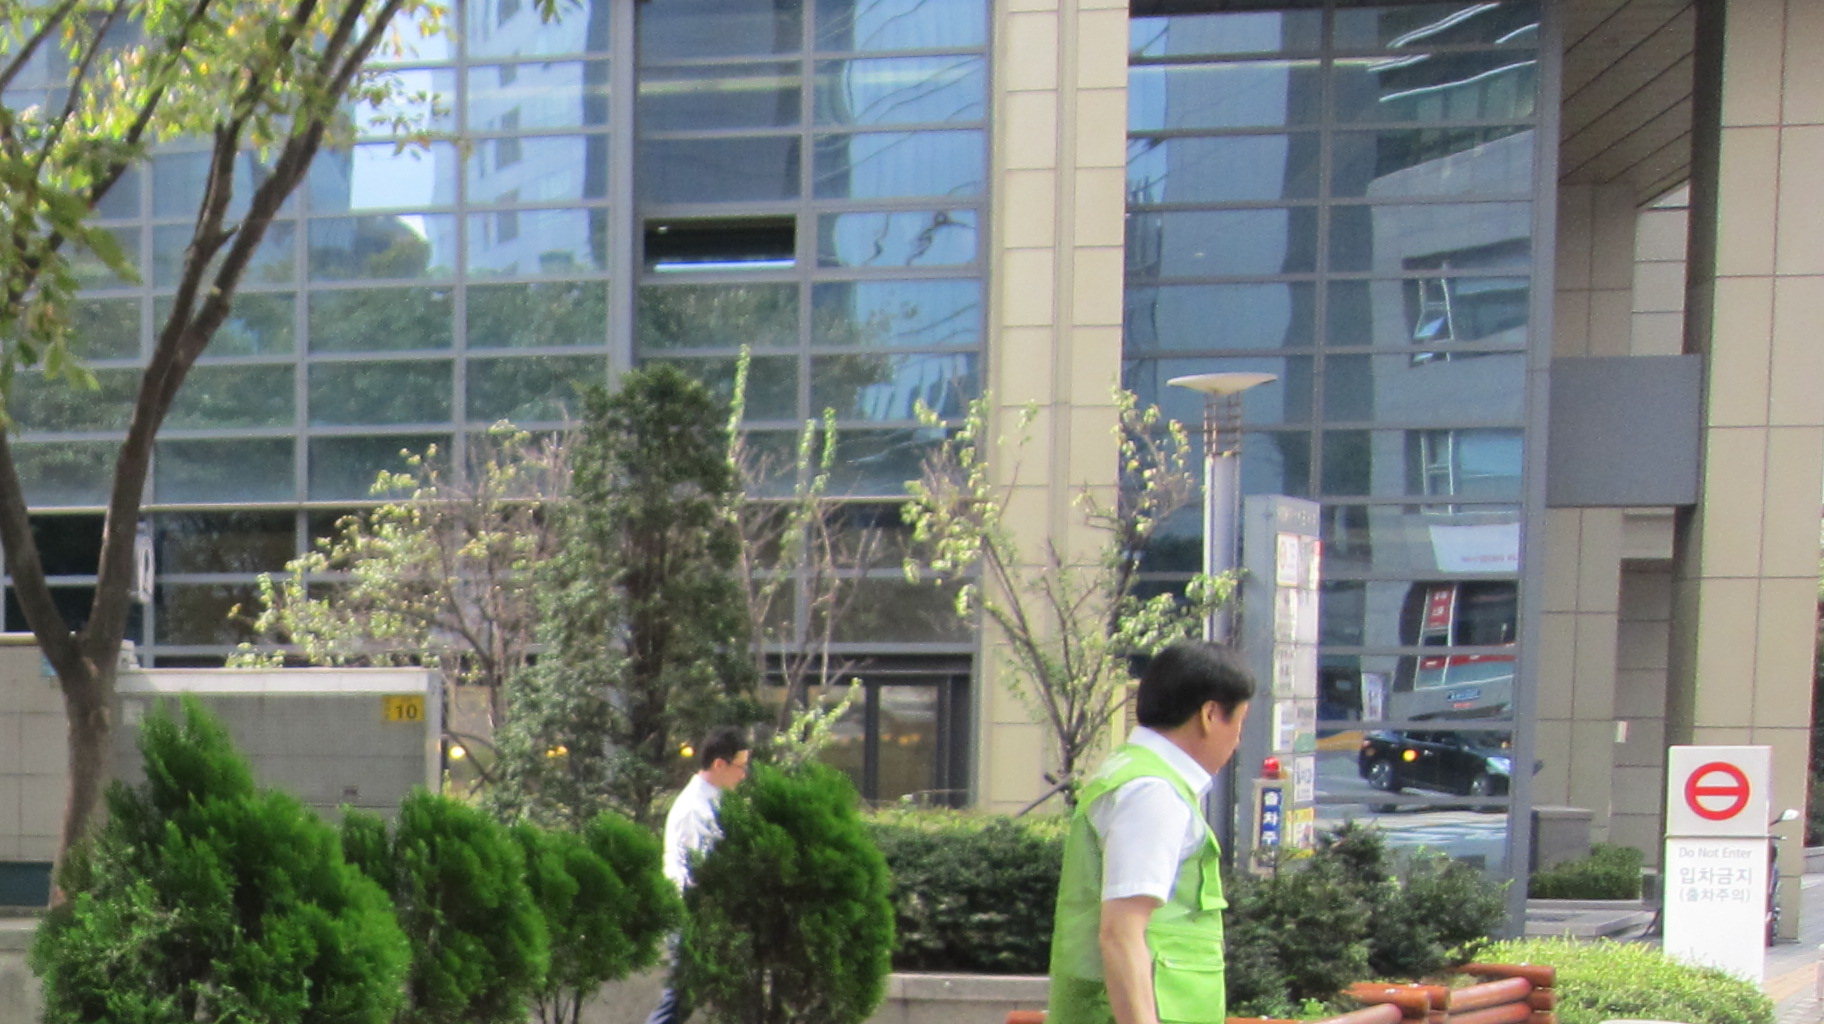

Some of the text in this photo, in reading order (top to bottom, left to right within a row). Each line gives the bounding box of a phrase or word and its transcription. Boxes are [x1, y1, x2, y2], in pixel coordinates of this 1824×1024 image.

[395, 704, 418, 719] 10
[1679, 847, 1753, 859] Do Not Enter
[1679, 867, 1752, 885] 입차금지
